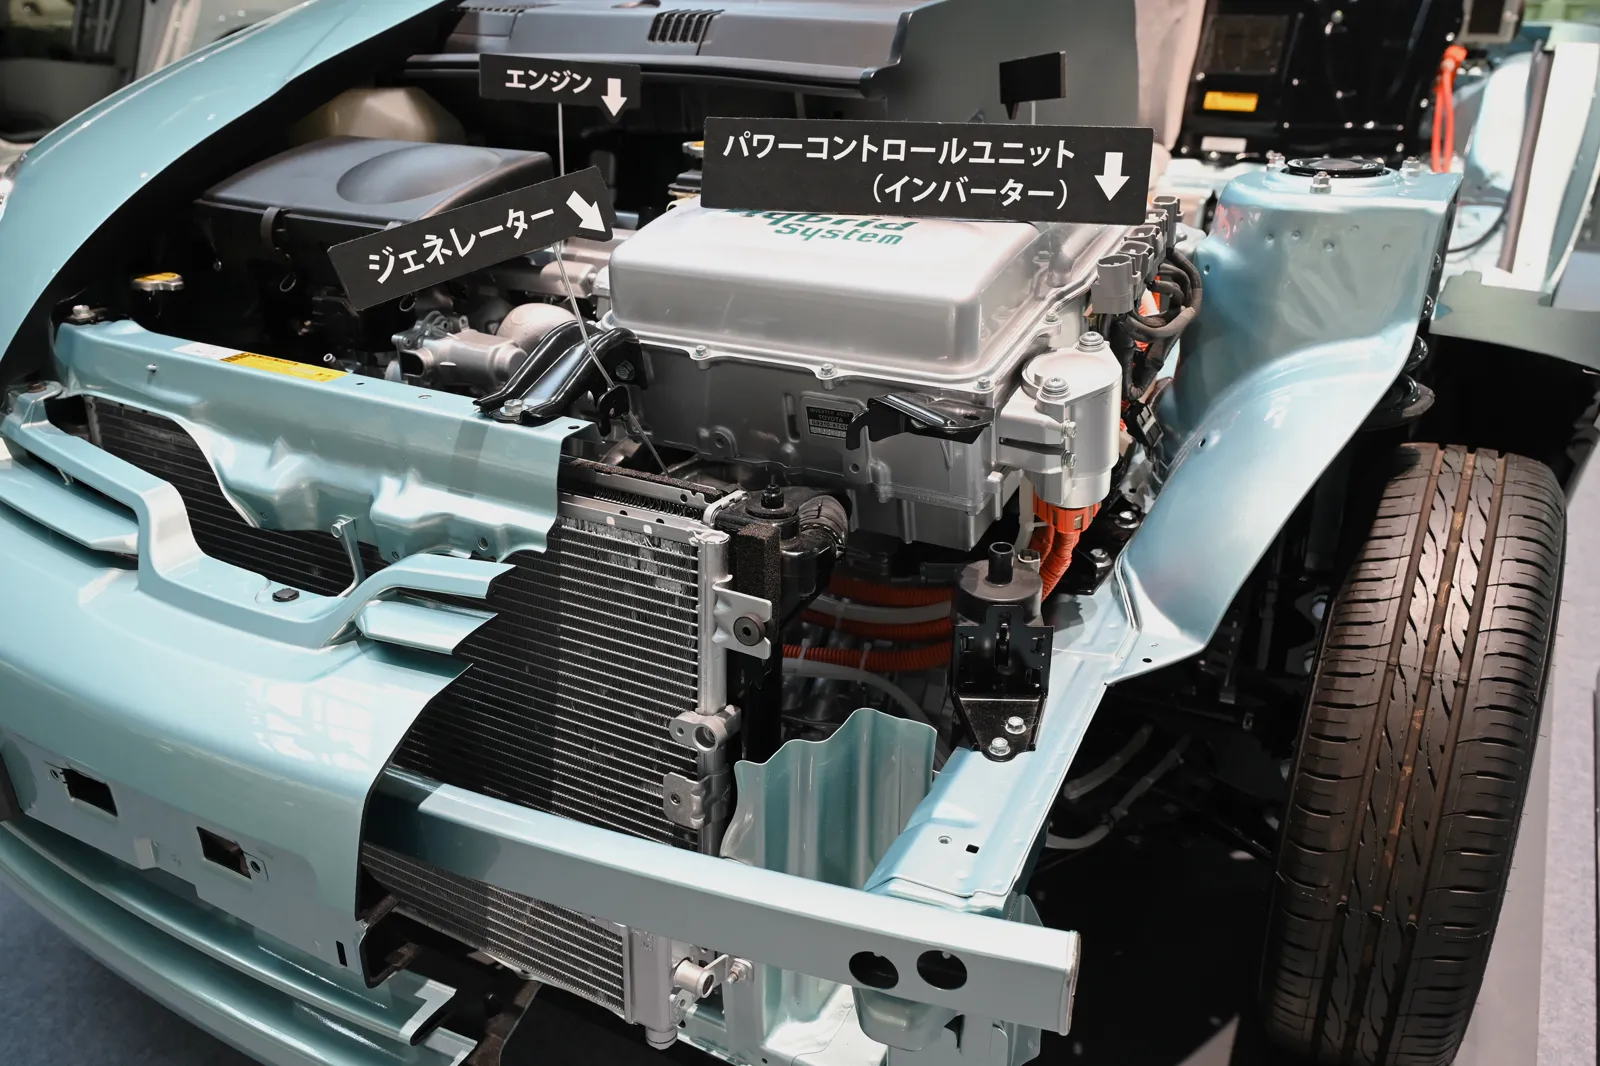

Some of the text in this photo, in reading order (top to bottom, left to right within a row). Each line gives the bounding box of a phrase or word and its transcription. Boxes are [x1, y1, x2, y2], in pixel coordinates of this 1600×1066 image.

[506, 70, 592, 94] エンジン
[722, 131, 1075, 169] パワーコントロールユニット
[368, 208, 555, 284] ジェネレーター
[774, 223, 903, 245] System
[818, 414, 844, 423] TOYOTA
